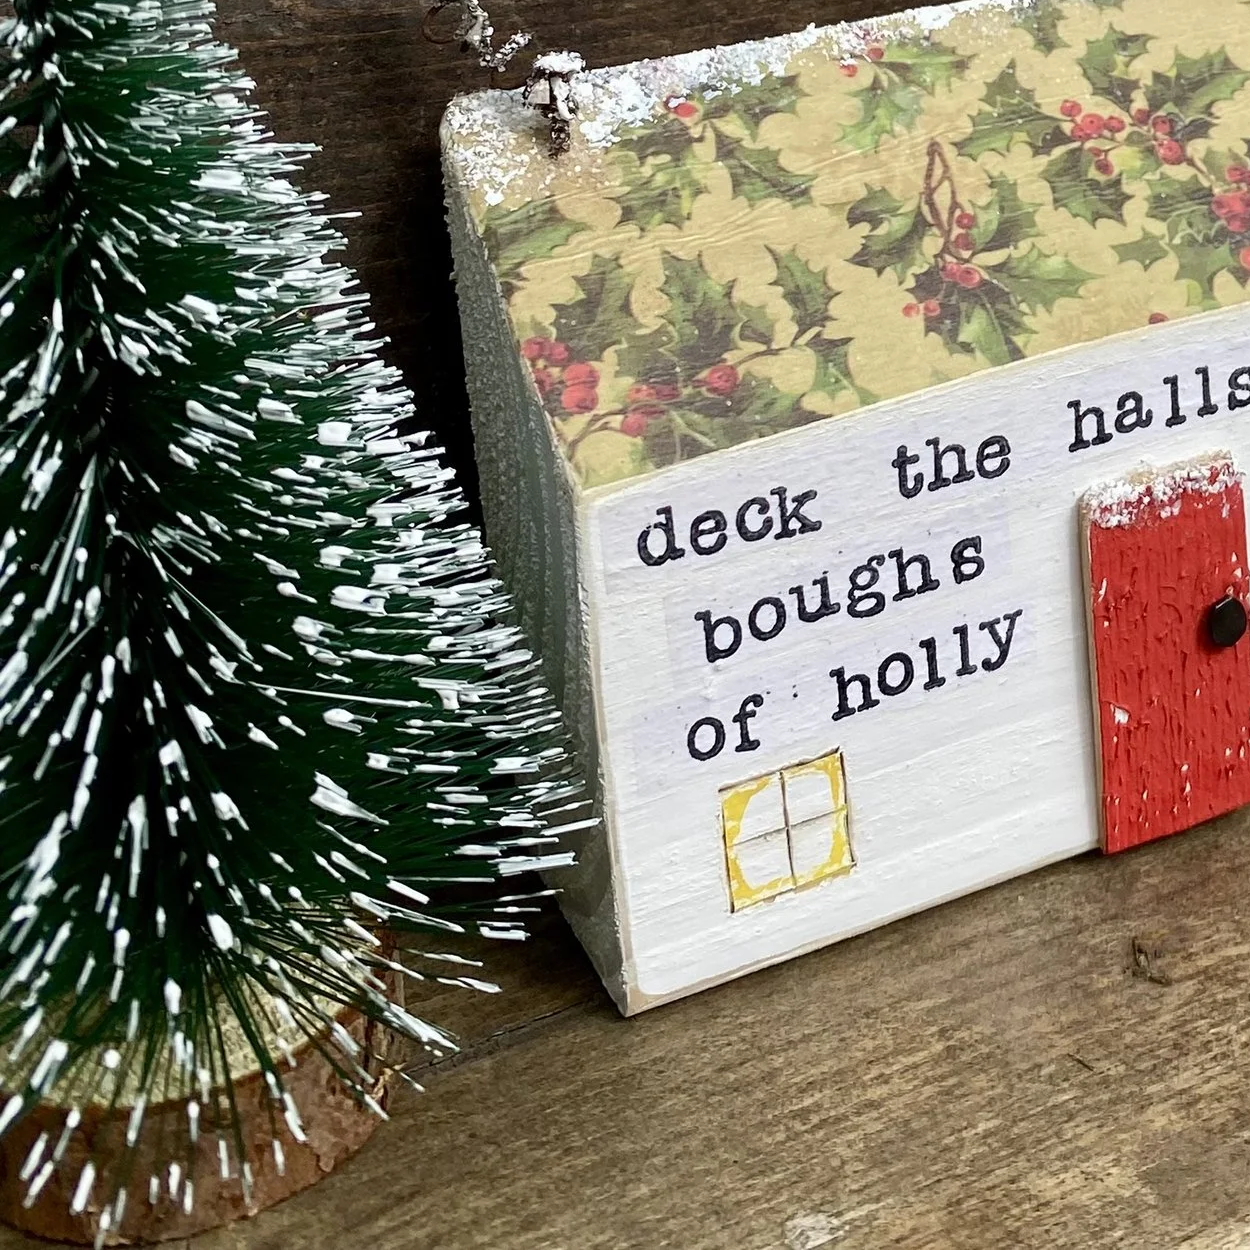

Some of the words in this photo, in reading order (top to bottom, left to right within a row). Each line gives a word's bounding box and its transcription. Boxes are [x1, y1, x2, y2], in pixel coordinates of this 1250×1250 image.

[636, 486, 823, 567] deck
[891, 435, 1012, 500] the
[694, 533, 986, 664] boughs
[686, 693, 764, 762] of
[829, 608, 1024, 722] holly
